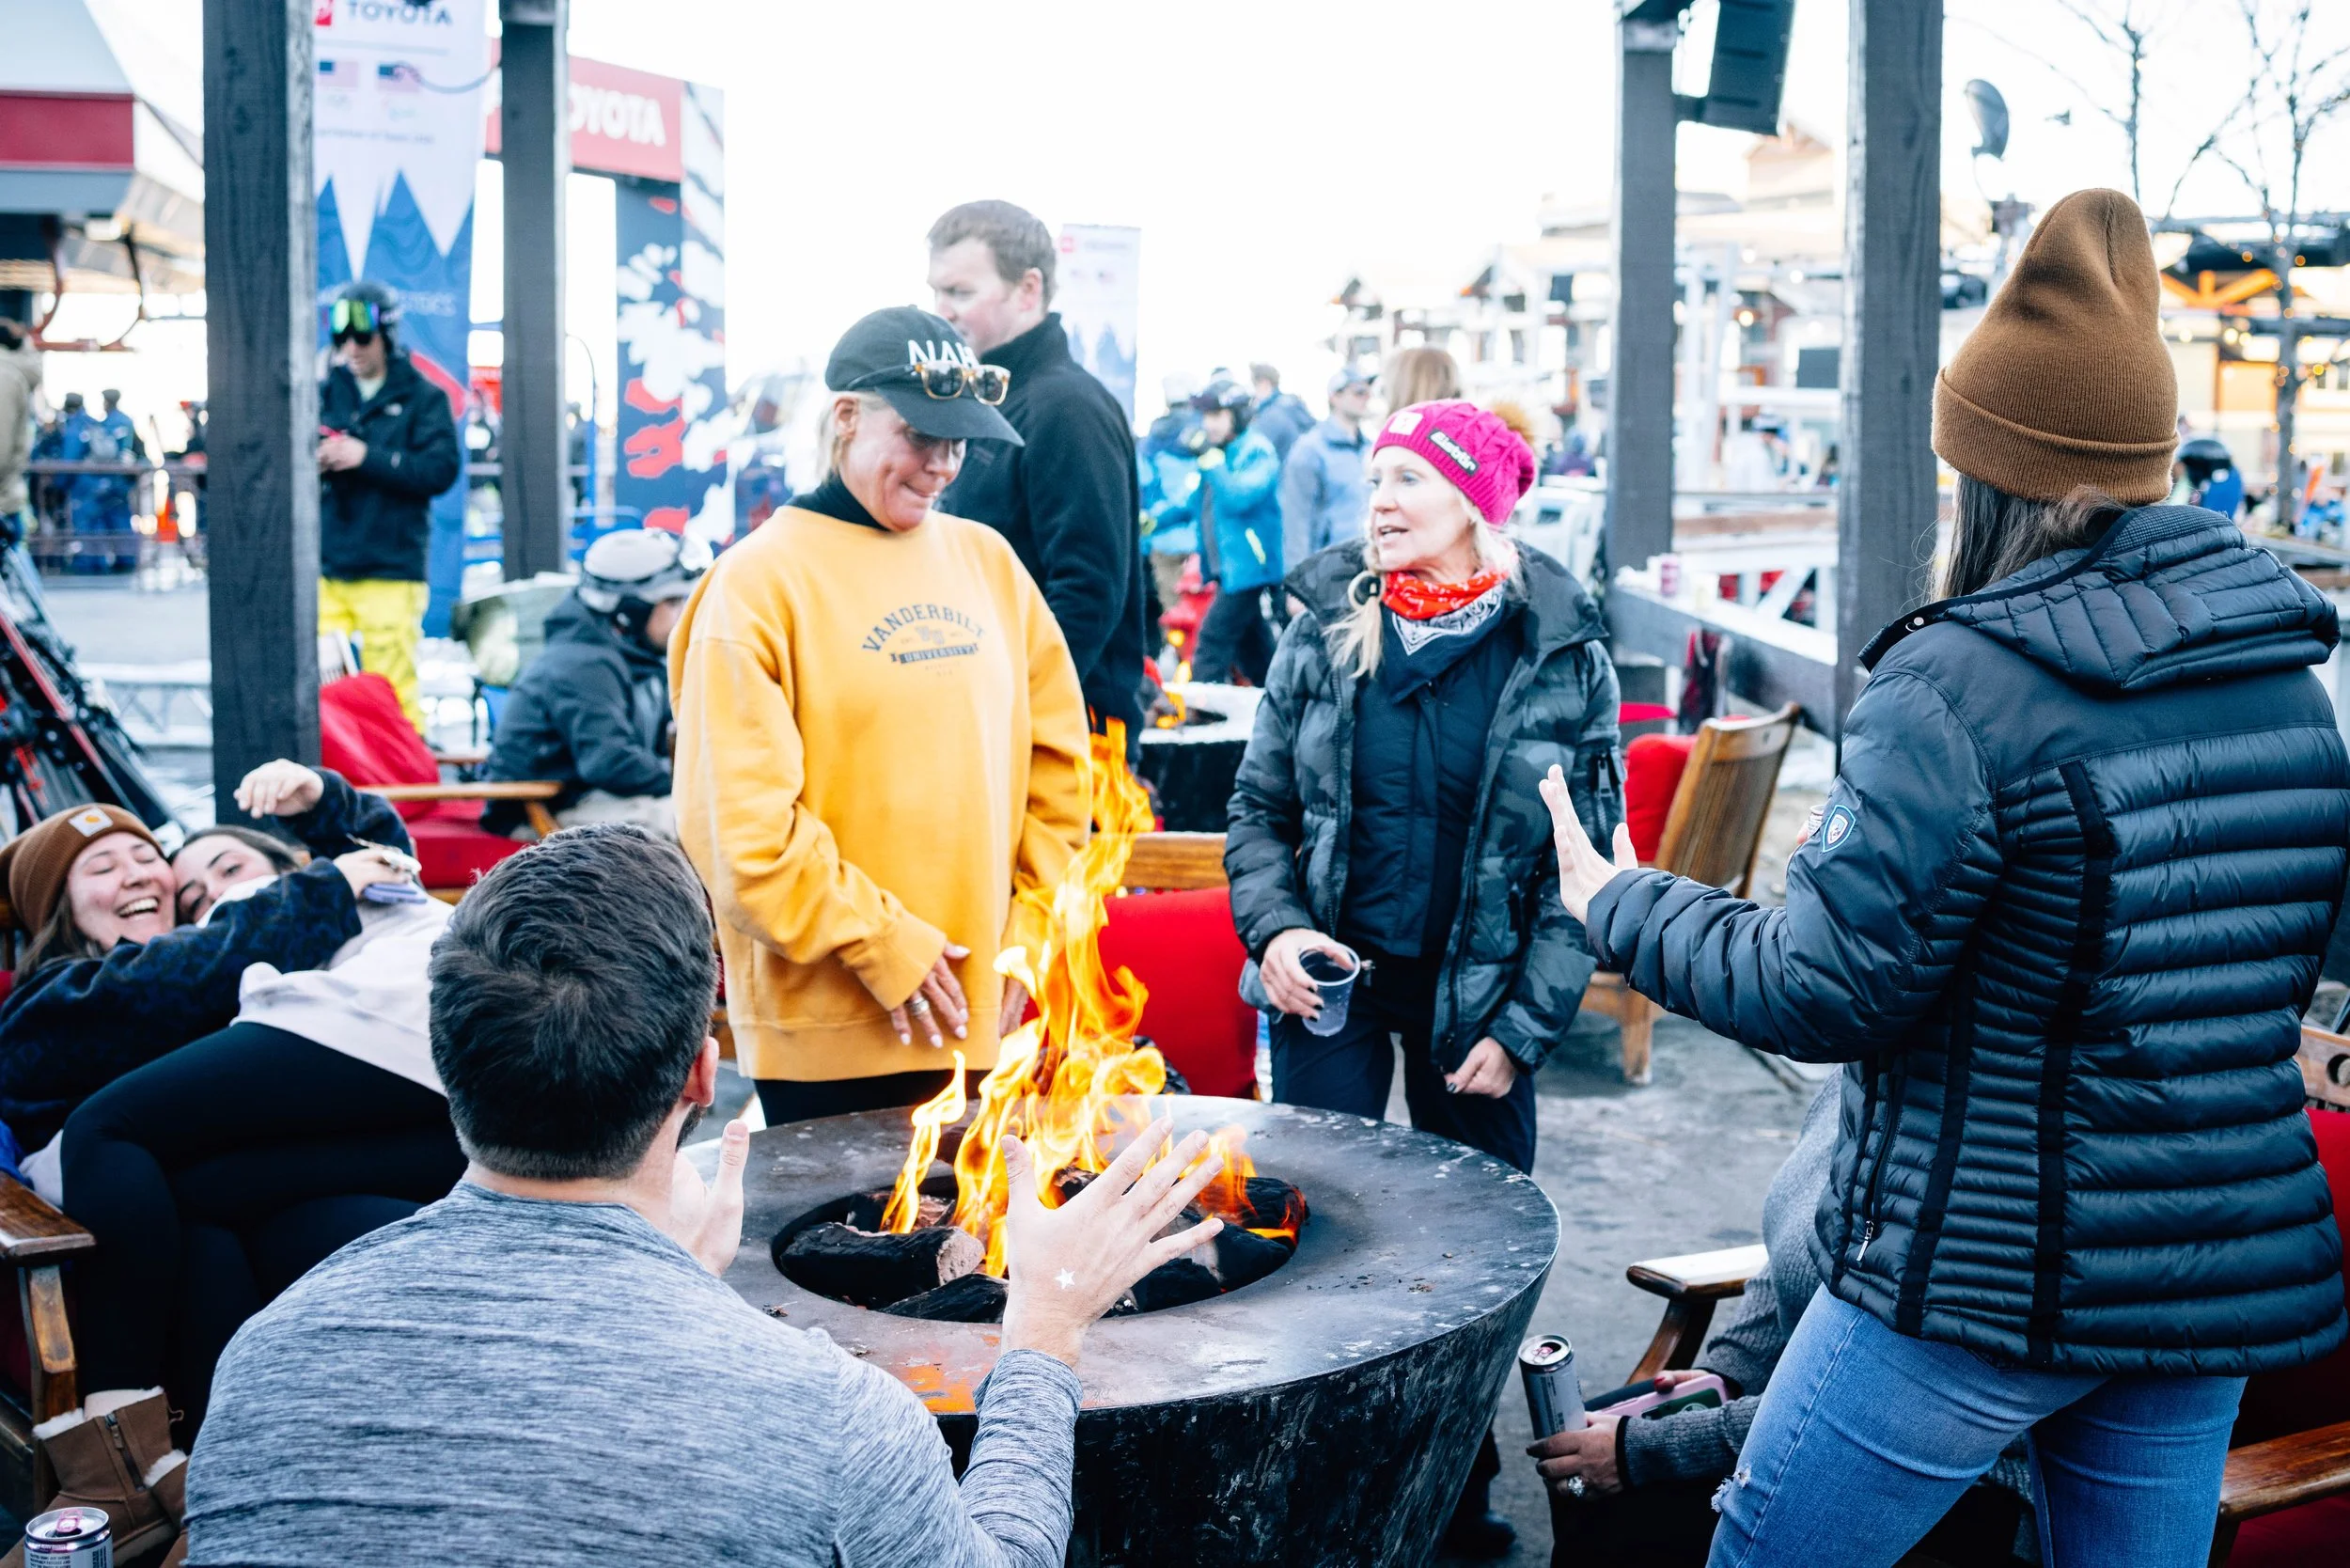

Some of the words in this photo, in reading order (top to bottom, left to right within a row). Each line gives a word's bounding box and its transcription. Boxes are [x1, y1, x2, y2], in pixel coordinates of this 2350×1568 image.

[568, 82, 666, 148] OYOTA
[862, 604, 984, 651] VANDERBILT
[902, 644, 974, 663] UNIVERSITY
